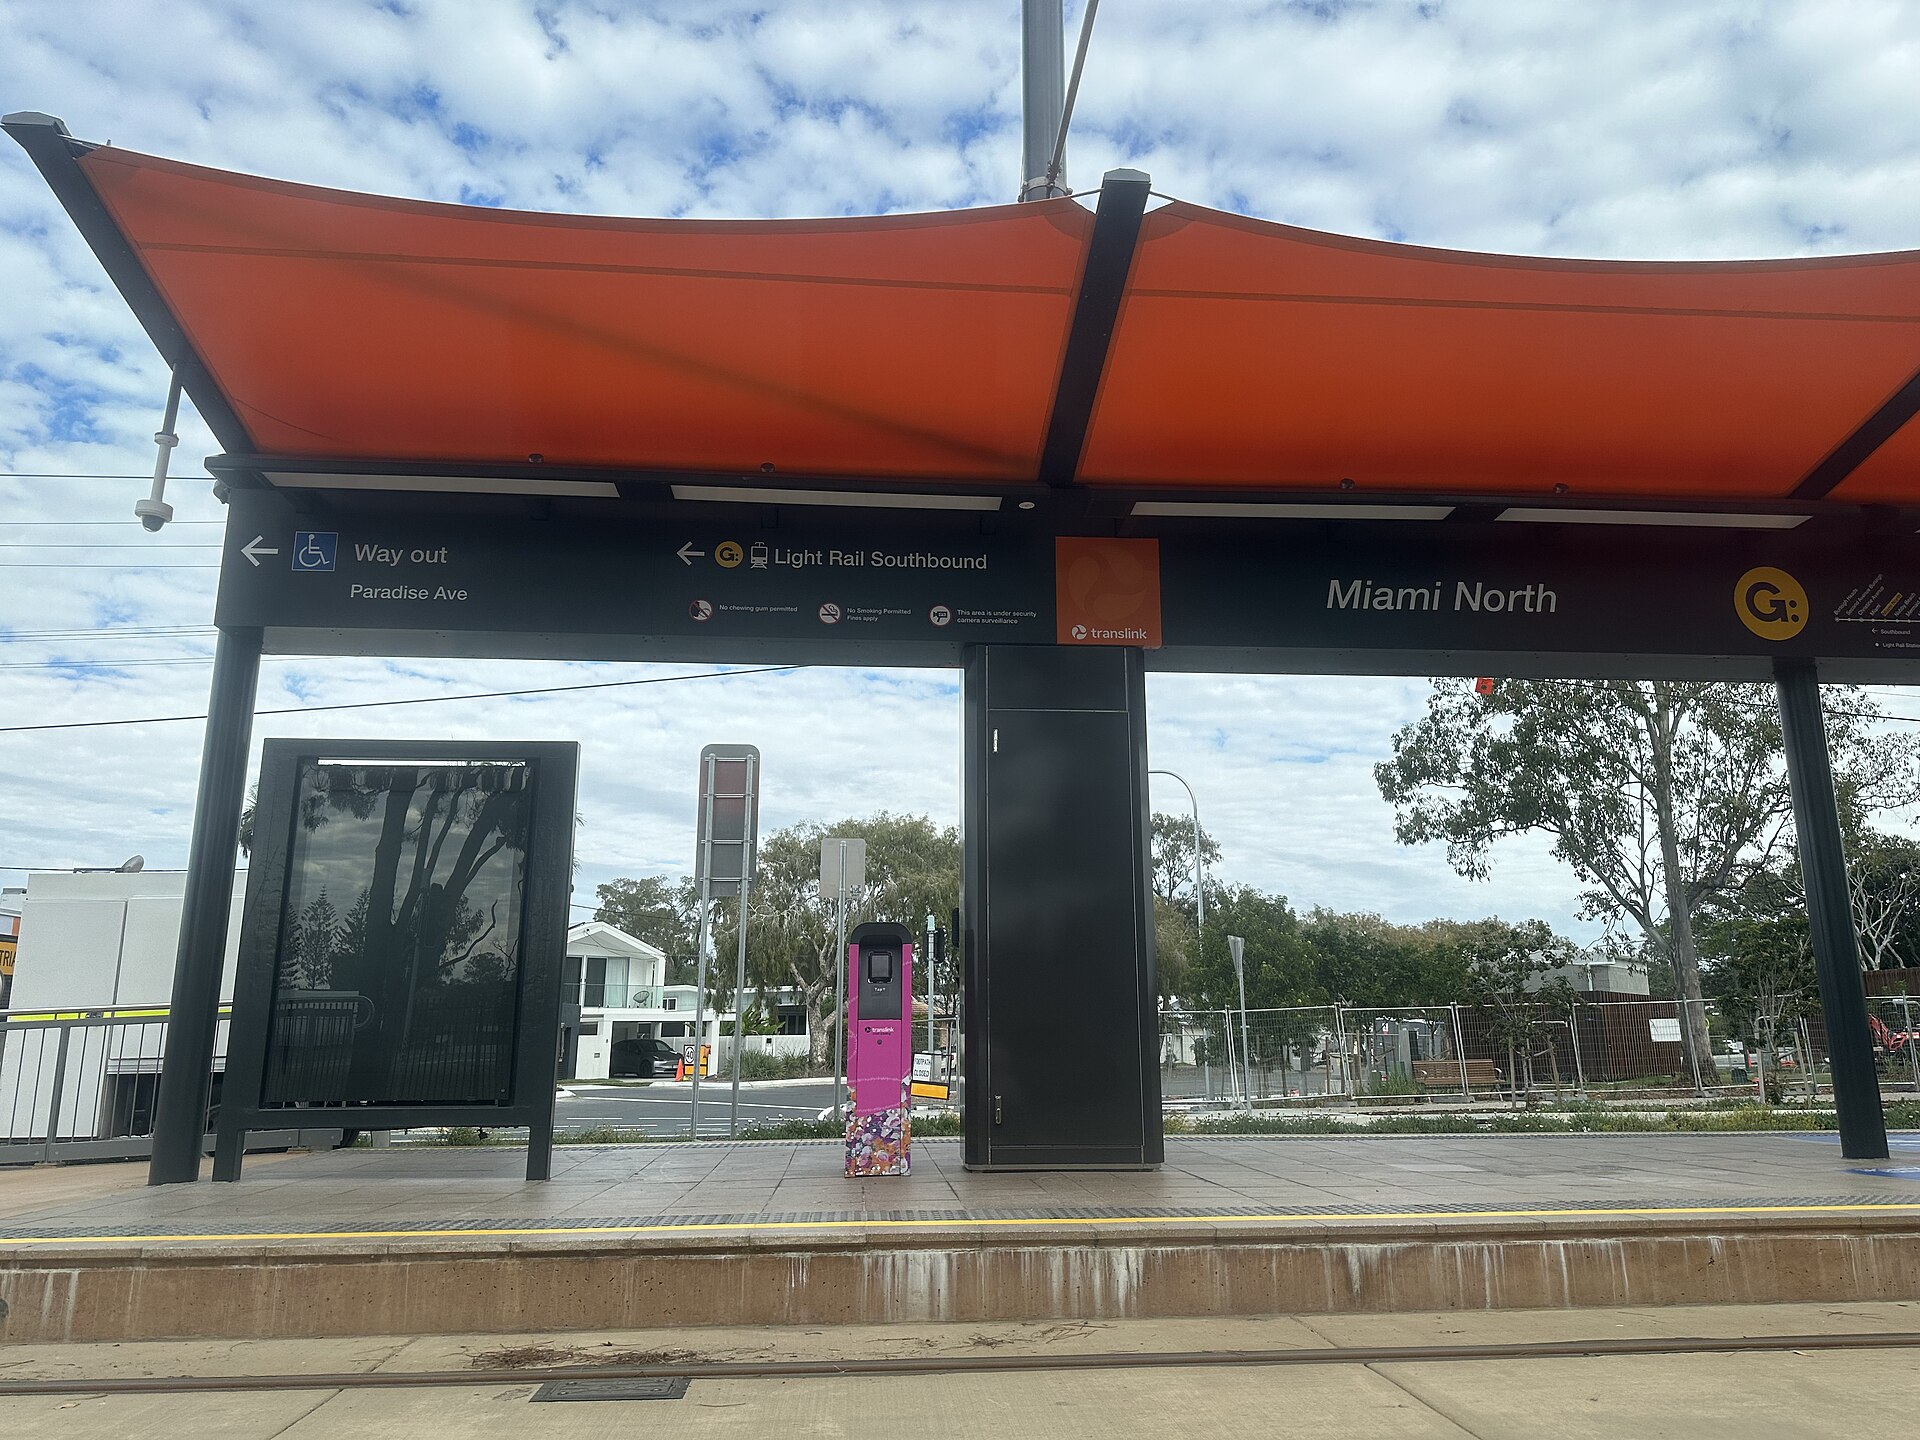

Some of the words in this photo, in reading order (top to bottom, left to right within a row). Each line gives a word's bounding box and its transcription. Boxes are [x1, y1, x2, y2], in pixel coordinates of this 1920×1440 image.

[354, 544, 404, 567] Way
[410, 547, 448, 564] out
[774, 548, 823, 569] Light
[829, 549, 865, 567] Rail
[870, 551, 988, 571] Southbound
[349, 584, 429, 601] Paradise
[433, 586, 468, 602] Ave
[1326, 578, 1442, 612] Miami
[1454, 581, 1557, 614] North
[729, 604, 754, 612] chewing
[856, 607, 882, 615] Smoking
[1012, 610, 1037, 618] security
[1091, 628, 1147, 639] translink
[914, 1069, 929, 1077] CLOSED
